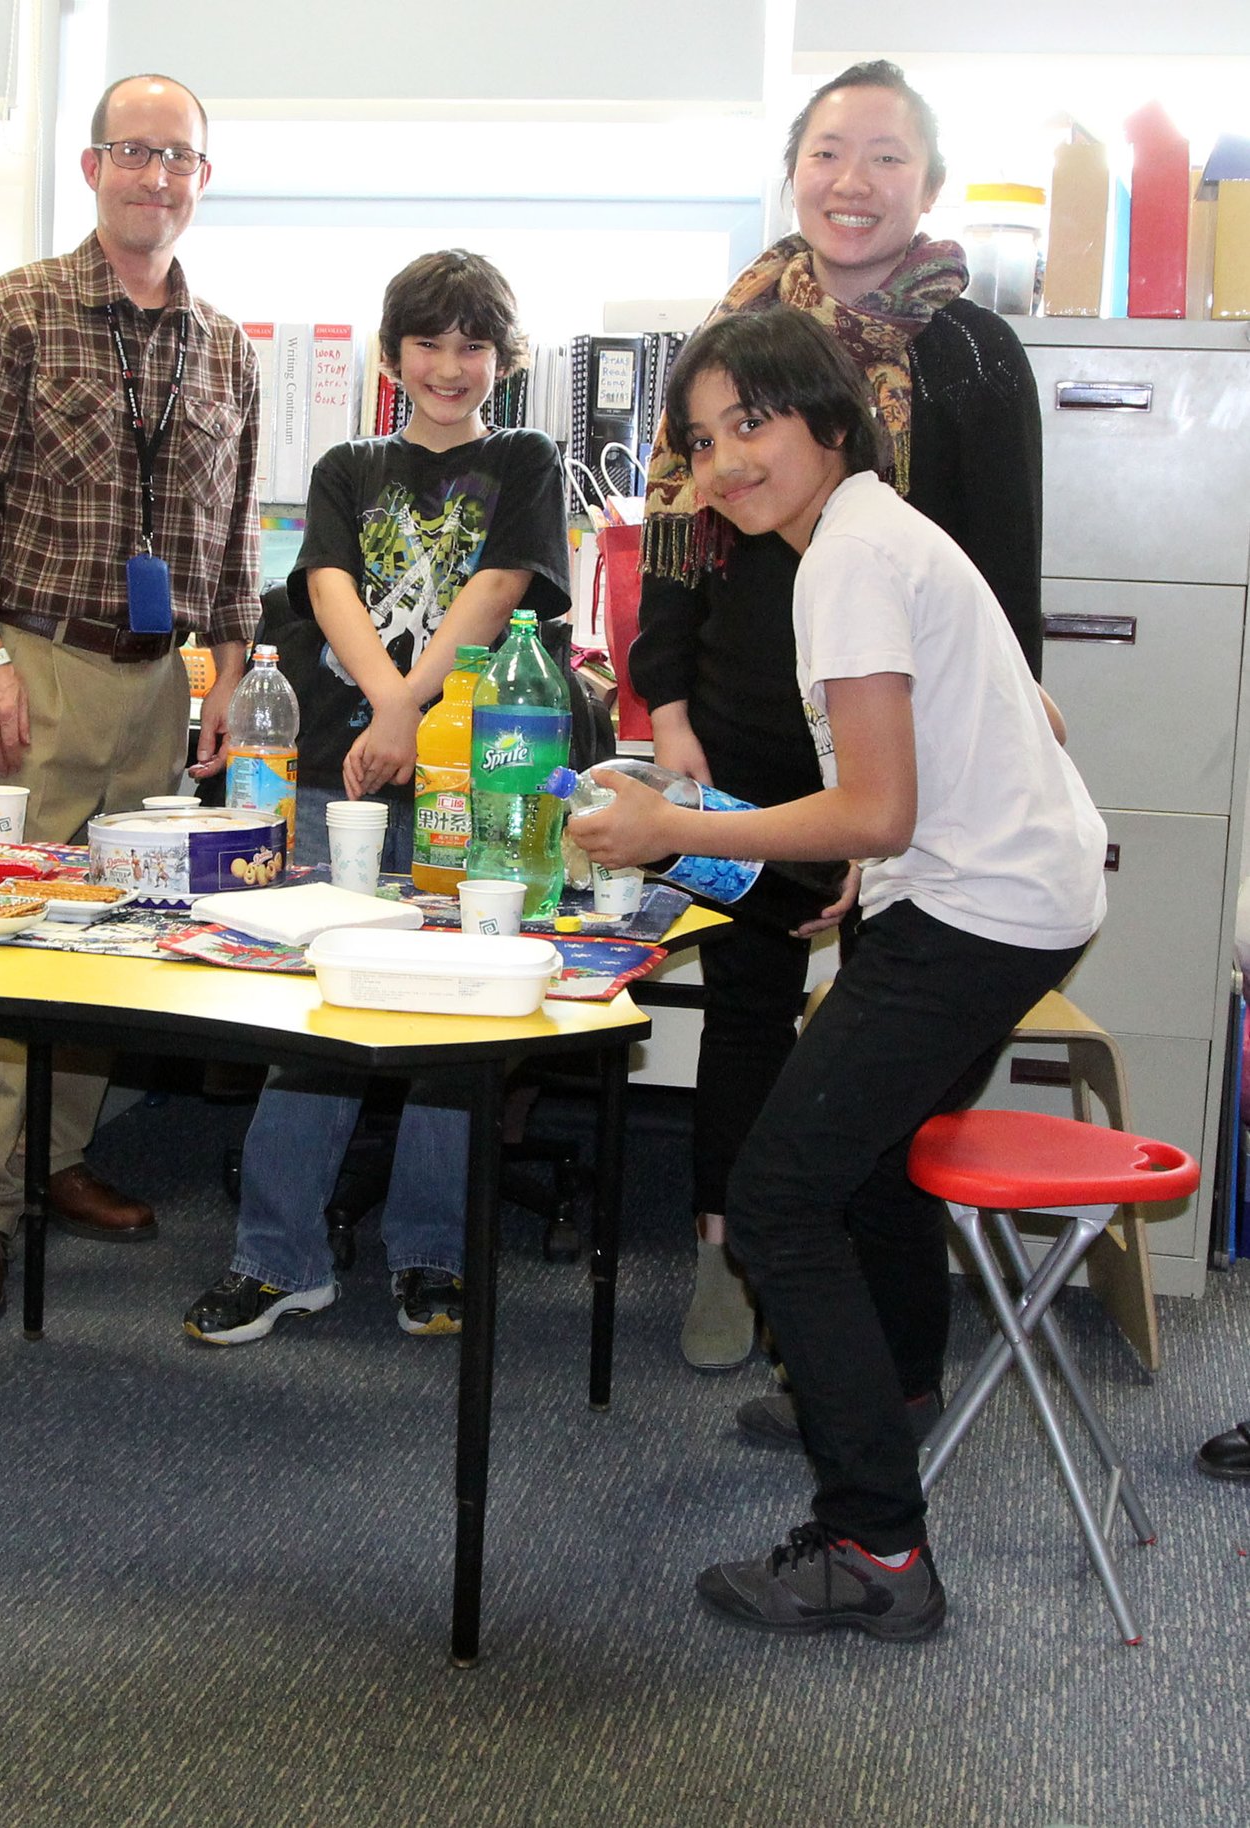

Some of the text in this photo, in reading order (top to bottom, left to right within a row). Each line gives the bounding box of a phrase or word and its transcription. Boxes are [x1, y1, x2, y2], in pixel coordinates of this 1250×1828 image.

[315, 348, 341, 359] WORD
[317, 363, 347, 378] STUDY
[284, 337, 298, 445] Writing Continuum
[482, 743, 528, 770] Sprite
[418, 808, 473, 833] 果汁系
